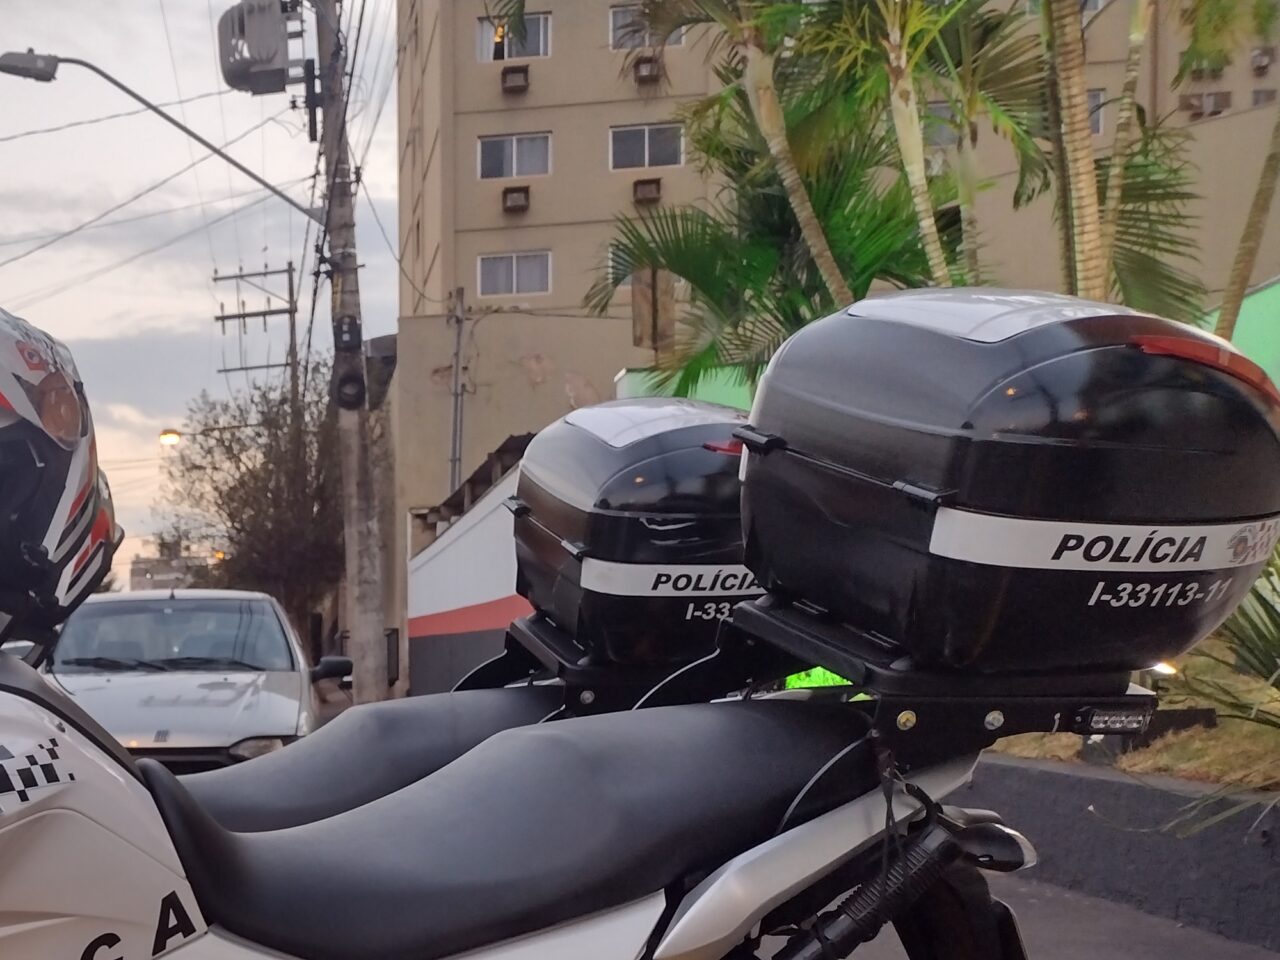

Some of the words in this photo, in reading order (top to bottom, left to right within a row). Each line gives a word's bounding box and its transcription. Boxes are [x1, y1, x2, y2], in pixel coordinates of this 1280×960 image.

[1051, 530, 1208, 563] POLÍCIA
[1088, 577, 1233, 607] I-33113-11
[685, 602, 735, 620] I-33
